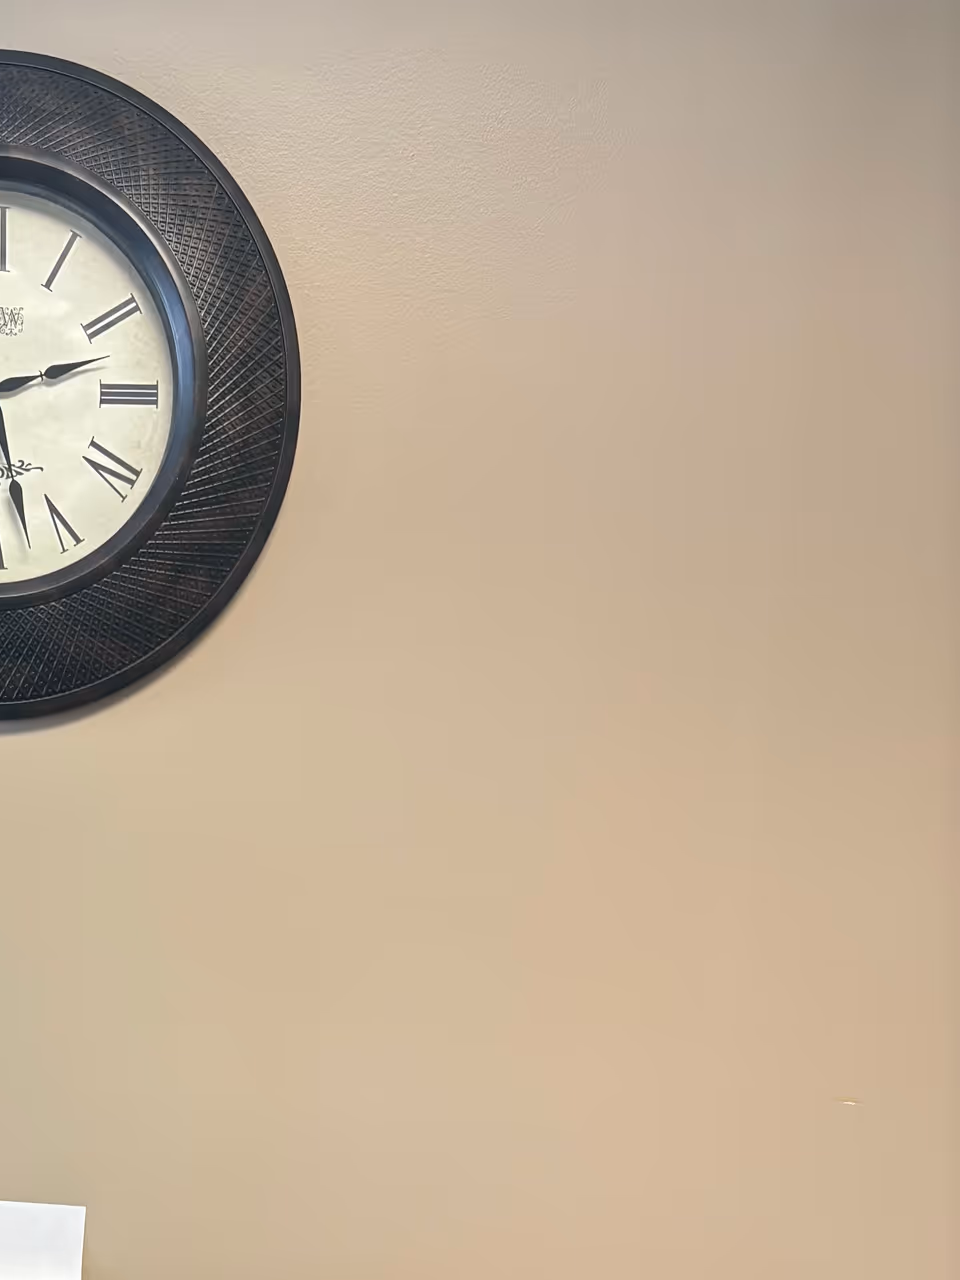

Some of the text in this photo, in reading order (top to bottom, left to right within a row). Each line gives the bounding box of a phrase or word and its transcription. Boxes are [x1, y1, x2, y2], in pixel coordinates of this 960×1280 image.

[40, 229, 82, 292] I
[81, 293, 143, 344] II
[99, 378, 159, 409] III
[81, 435, 143, 503] IV
[43, 493, 86, 555] V
